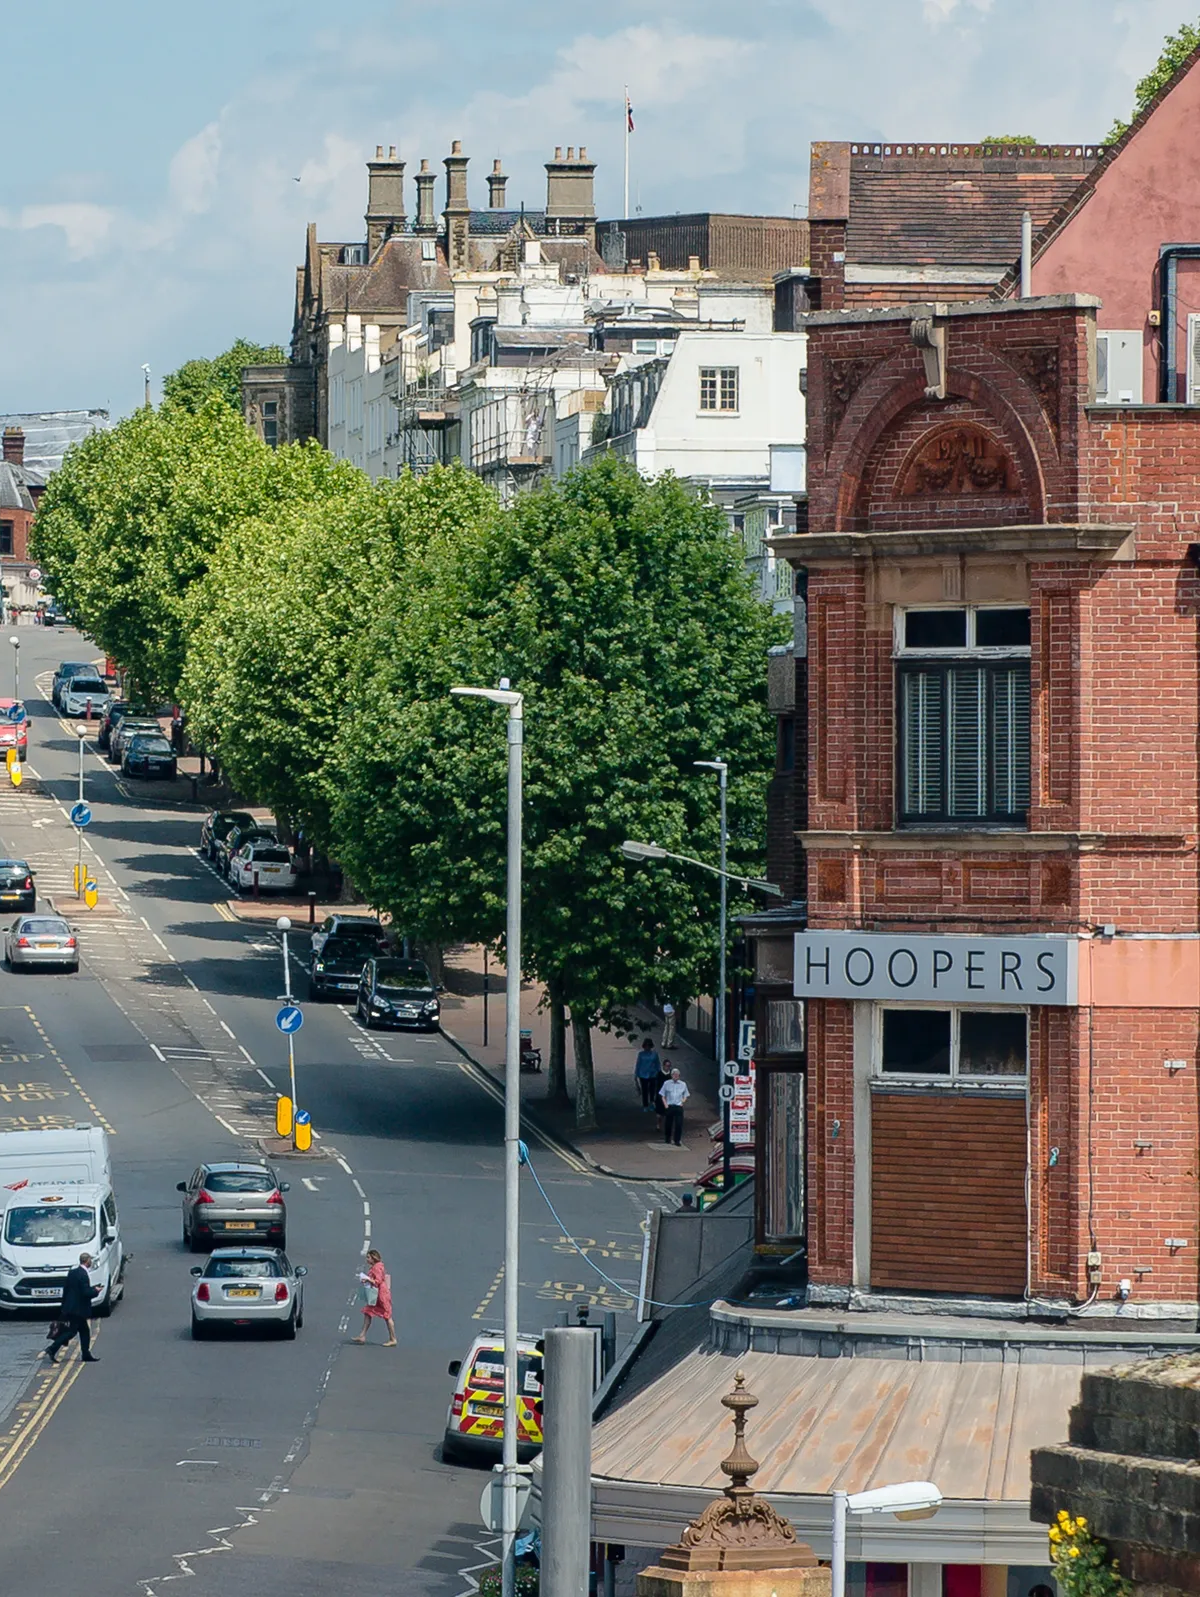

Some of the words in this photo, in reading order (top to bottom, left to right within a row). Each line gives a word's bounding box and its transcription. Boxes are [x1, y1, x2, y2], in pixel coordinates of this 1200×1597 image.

[806, 946, 1056, 992] HOOPERS
[726, 1064, 737, 1074] T
[722, 1088, 731, 1098] U
